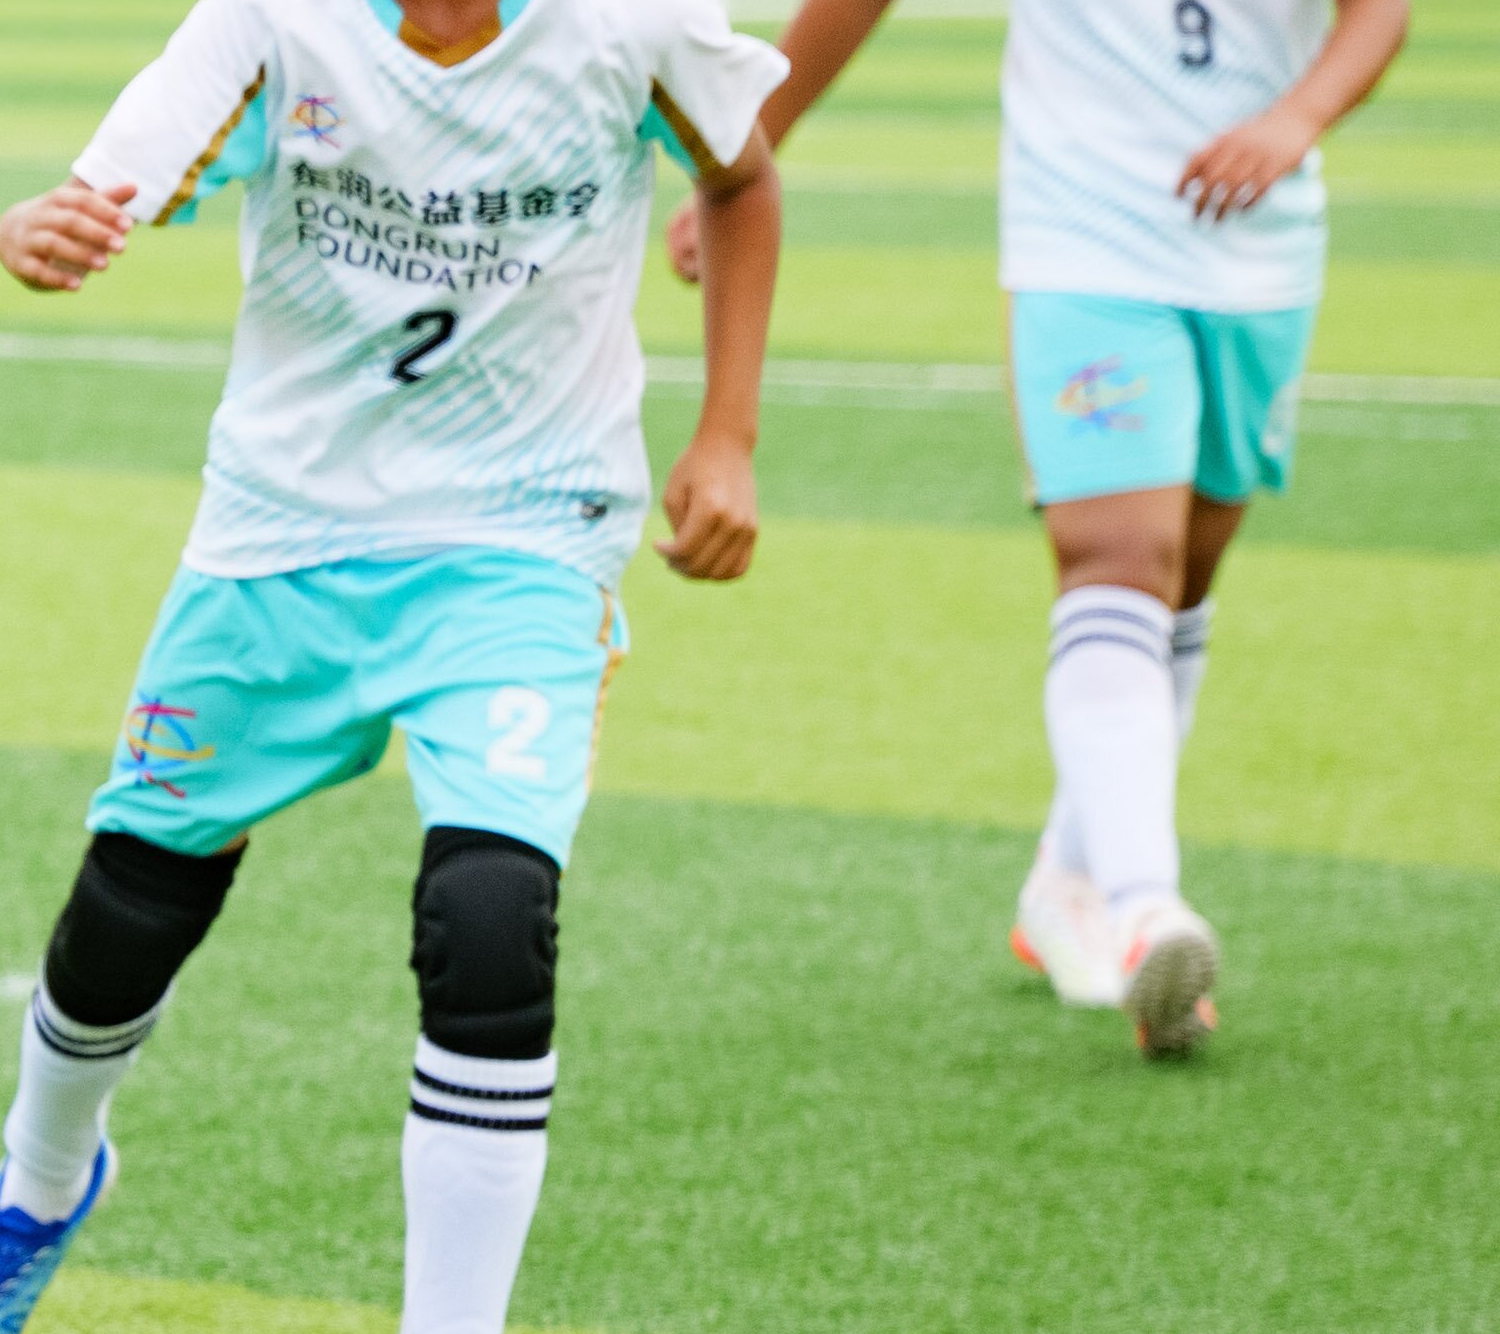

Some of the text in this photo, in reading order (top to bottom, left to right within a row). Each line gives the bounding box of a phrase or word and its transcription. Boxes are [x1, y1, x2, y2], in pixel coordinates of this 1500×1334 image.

[296, 196, 500, 263] DONGRUN
[389, 309, 460, 385] 2
[486, 685, 551, 780] 2
